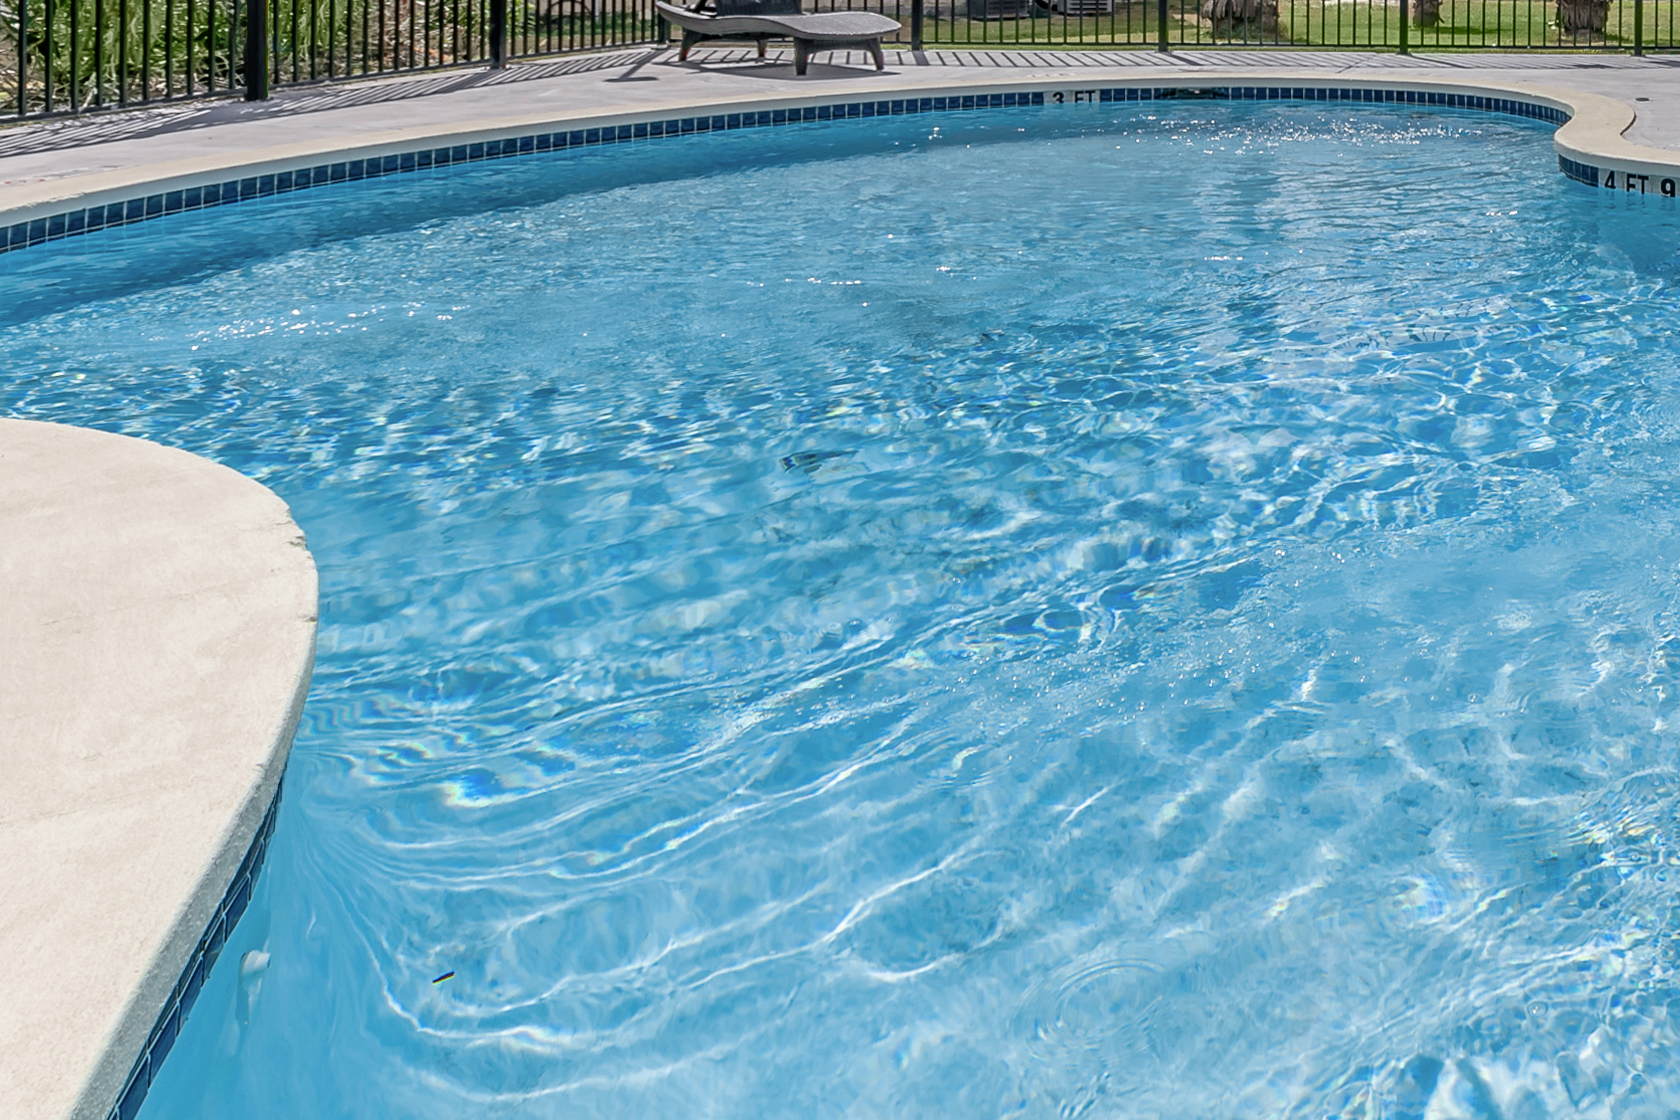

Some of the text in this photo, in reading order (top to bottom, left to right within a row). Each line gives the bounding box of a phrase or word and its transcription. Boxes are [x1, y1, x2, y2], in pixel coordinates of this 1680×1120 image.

[1052, 90, 1096, 103] 3 FT
[1604, 170, 1616, 189] 4
[1626, 173, 1649, 194] FT
[1660, 178, 1676, 198] 9
